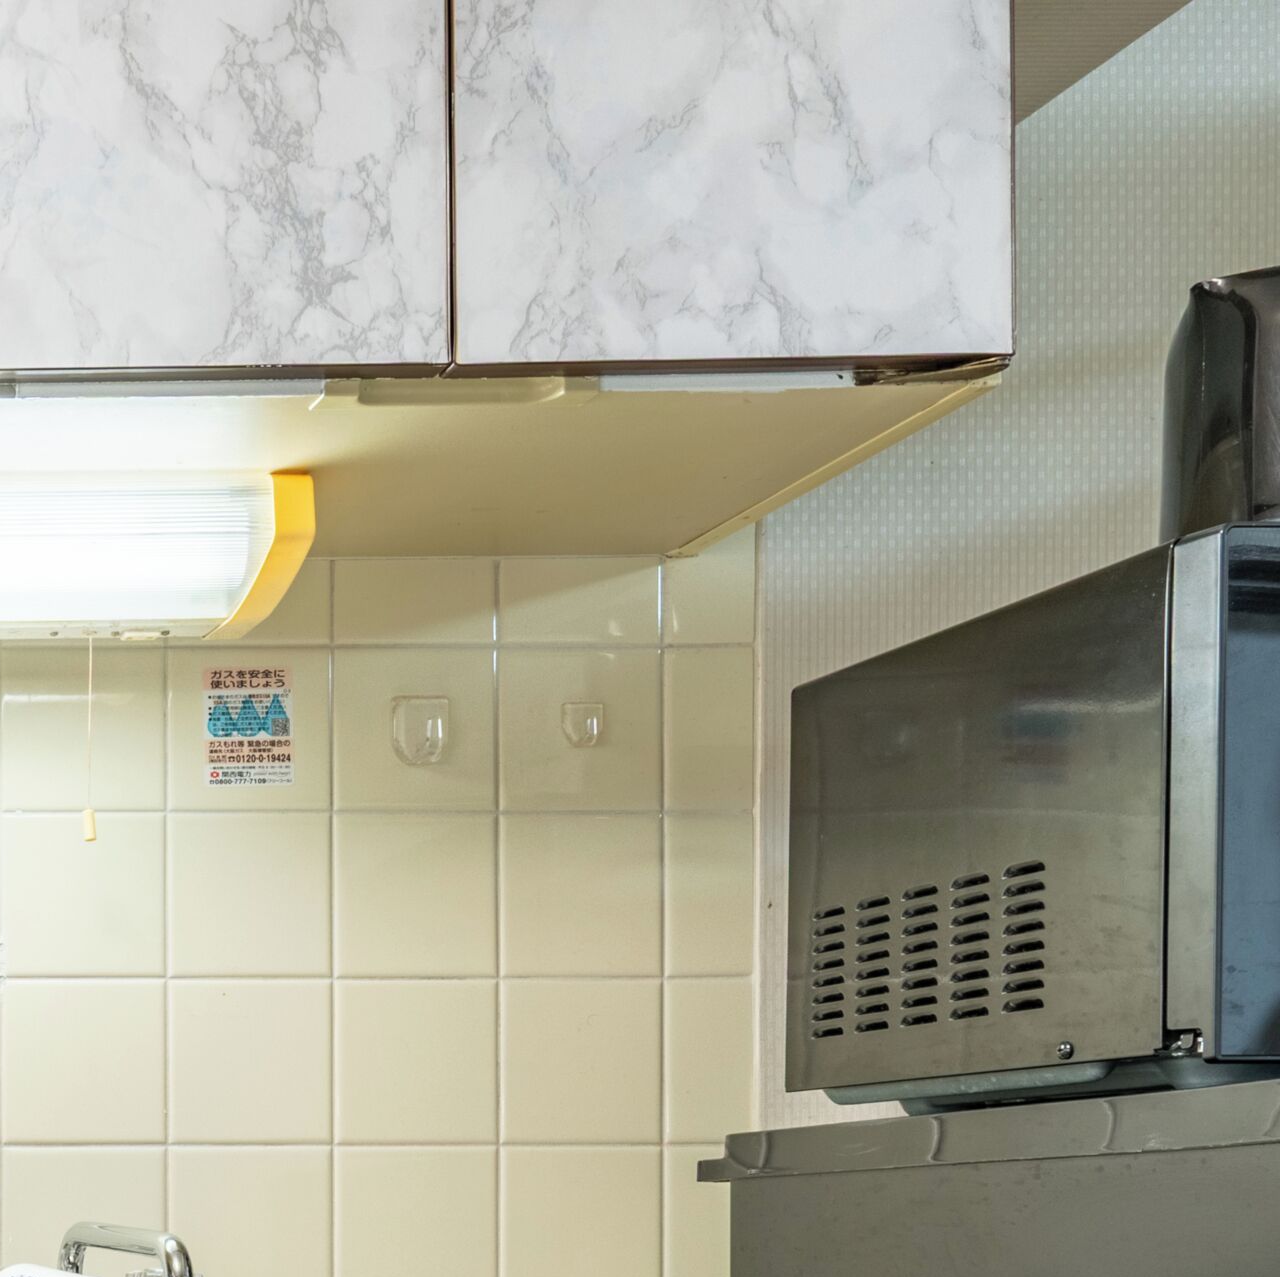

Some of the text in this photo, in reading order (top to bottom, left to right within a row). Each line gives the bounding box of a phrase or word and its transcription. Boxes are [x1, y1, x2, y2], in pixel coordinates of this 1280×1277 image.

[210, 669, 286, 680] ガスを安全に
[210, 679, 286, 690] 使いましょう
[236, 753, 291, 763] 0120-0-19424
